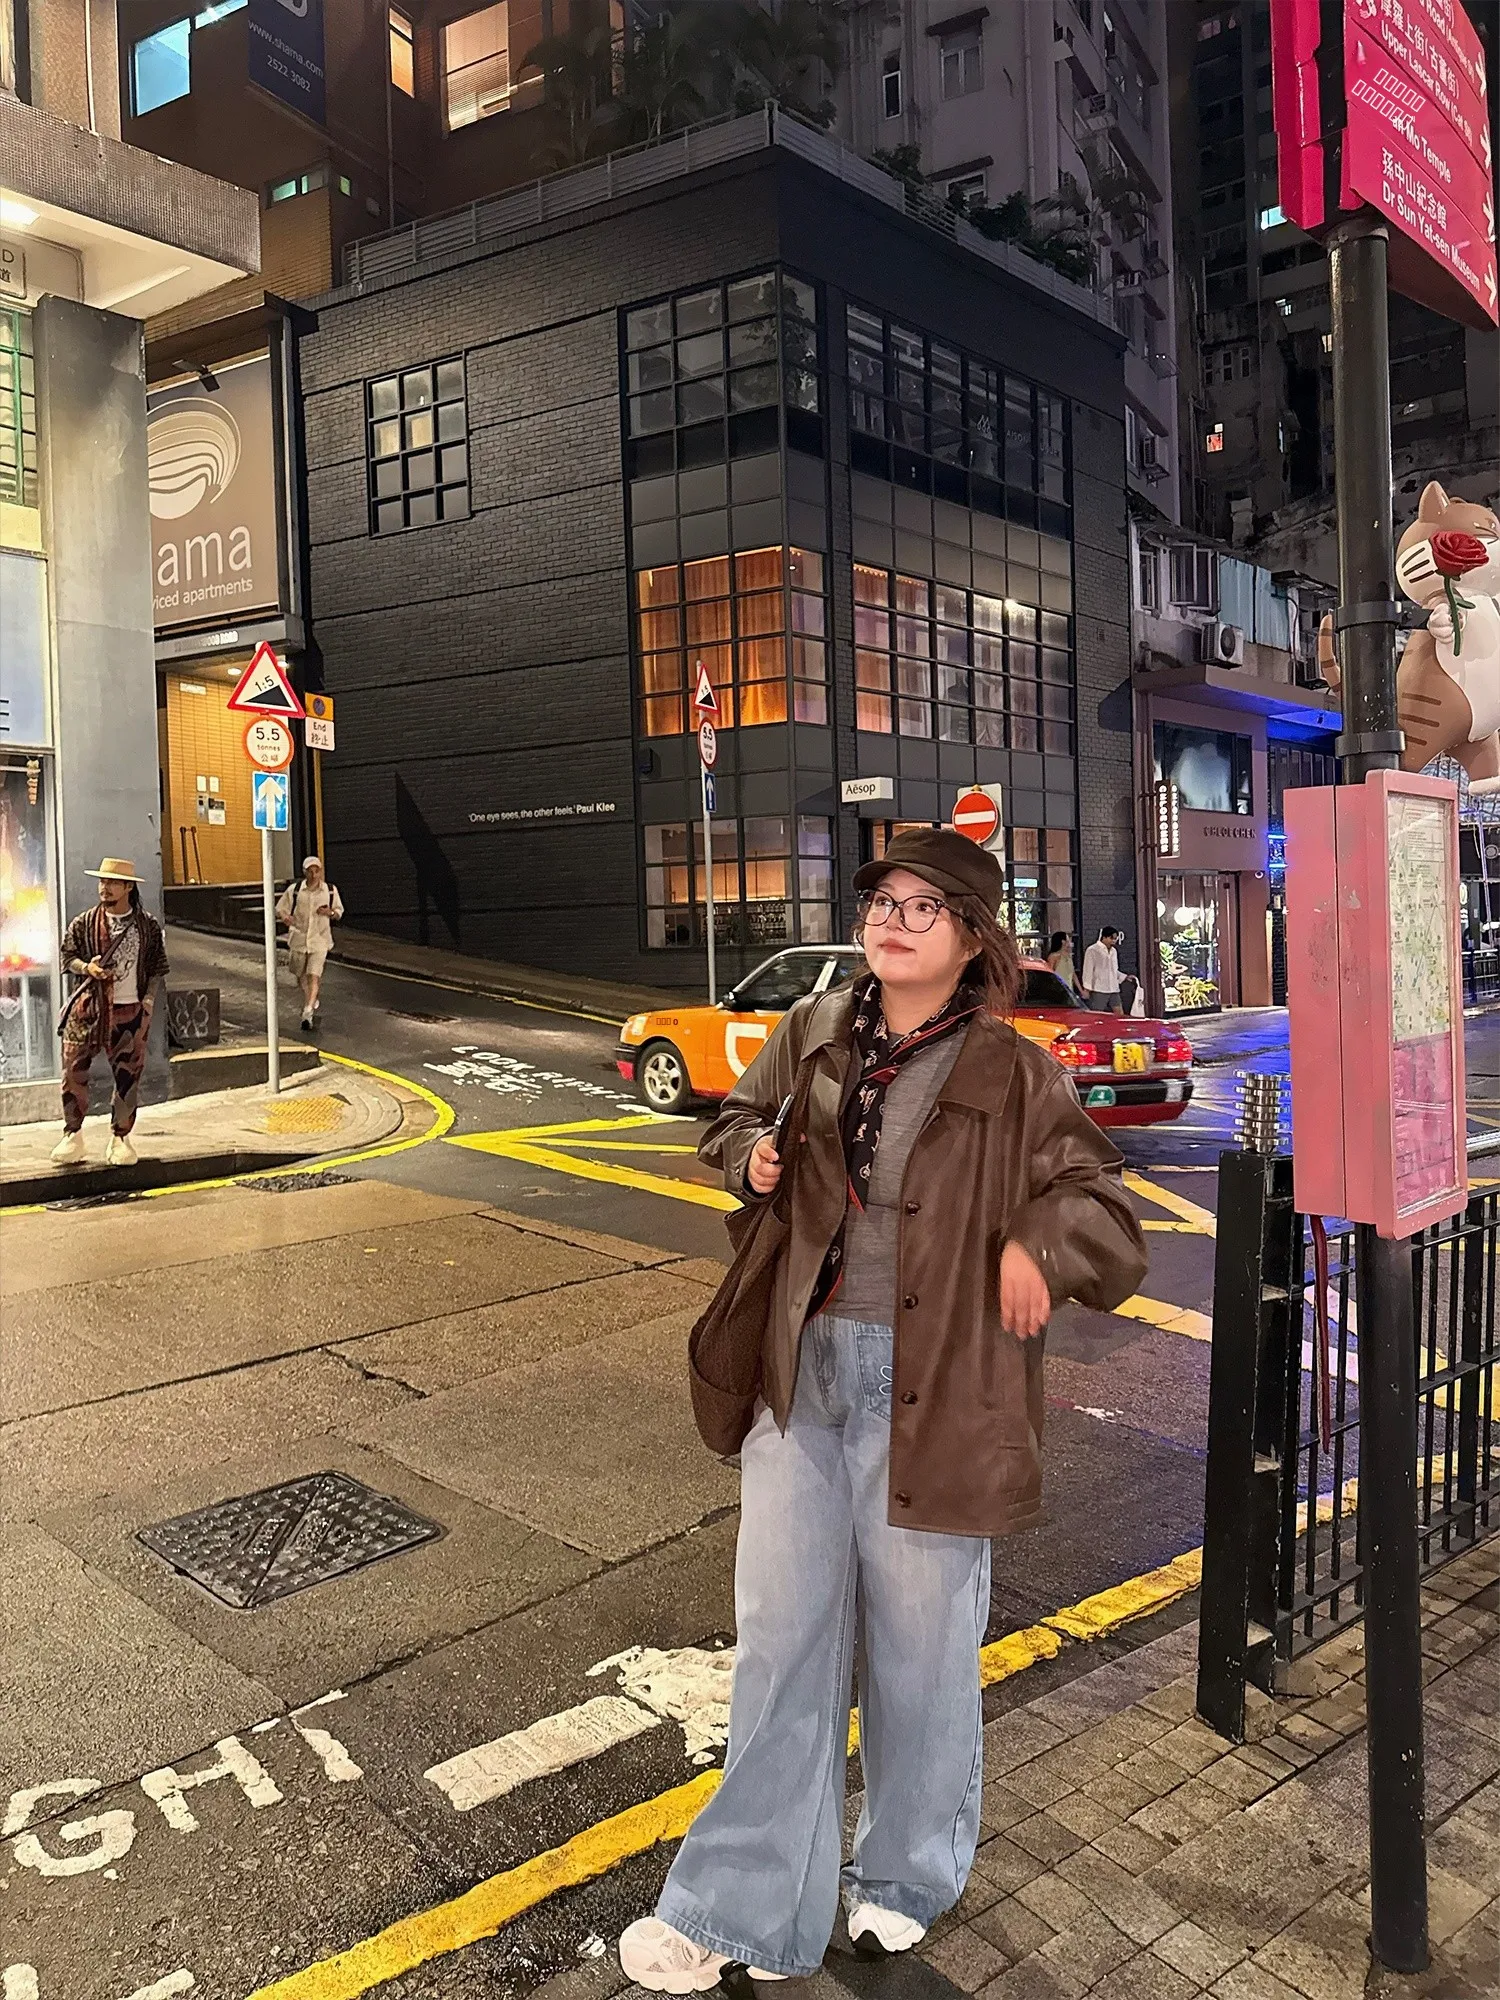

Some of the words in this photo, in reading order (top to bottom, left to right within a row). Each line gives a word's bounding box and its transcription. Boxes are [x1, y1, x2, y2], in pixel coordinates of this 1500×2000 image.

[248, 18, 323, 79] www.shama.com
[1381, 19, 1408, 61] Upper
[1408, 49, 1435, 92] Lascar
[1435, 81, 1451, 112] Row
[267, 54, 289, 78] 2522
[290, 70, 311, 93] 3082
[1421, 135, 1452, 184] Temple
[1382, 147, 1448, 232] 孫中山紀念館
[1382, 181, 1395, 208] Dr
[1396, 194, 1417, 228] Sun
[1417, 213, 1451, 260] Yat-sen
[1451, 244, 1481, 292] Museum
[157, 525, 252, 587] ama
[182, 577, 254, 606] apartments
[254, 675, 275, 692] 1:5
[256, 727, 281, 741] 5.5
[313, 721, 327, 732] End
[256, 744, 281, 752] tonnes
[486, 812, 500, 823] eye
[520, 809, 533, 819] the
[533, 808, 554, 818] other
[576, 803, 595, 814] Paul
[596, 801, 616, 812] Klee
[451, 1045, 536, 1072] LOOK
